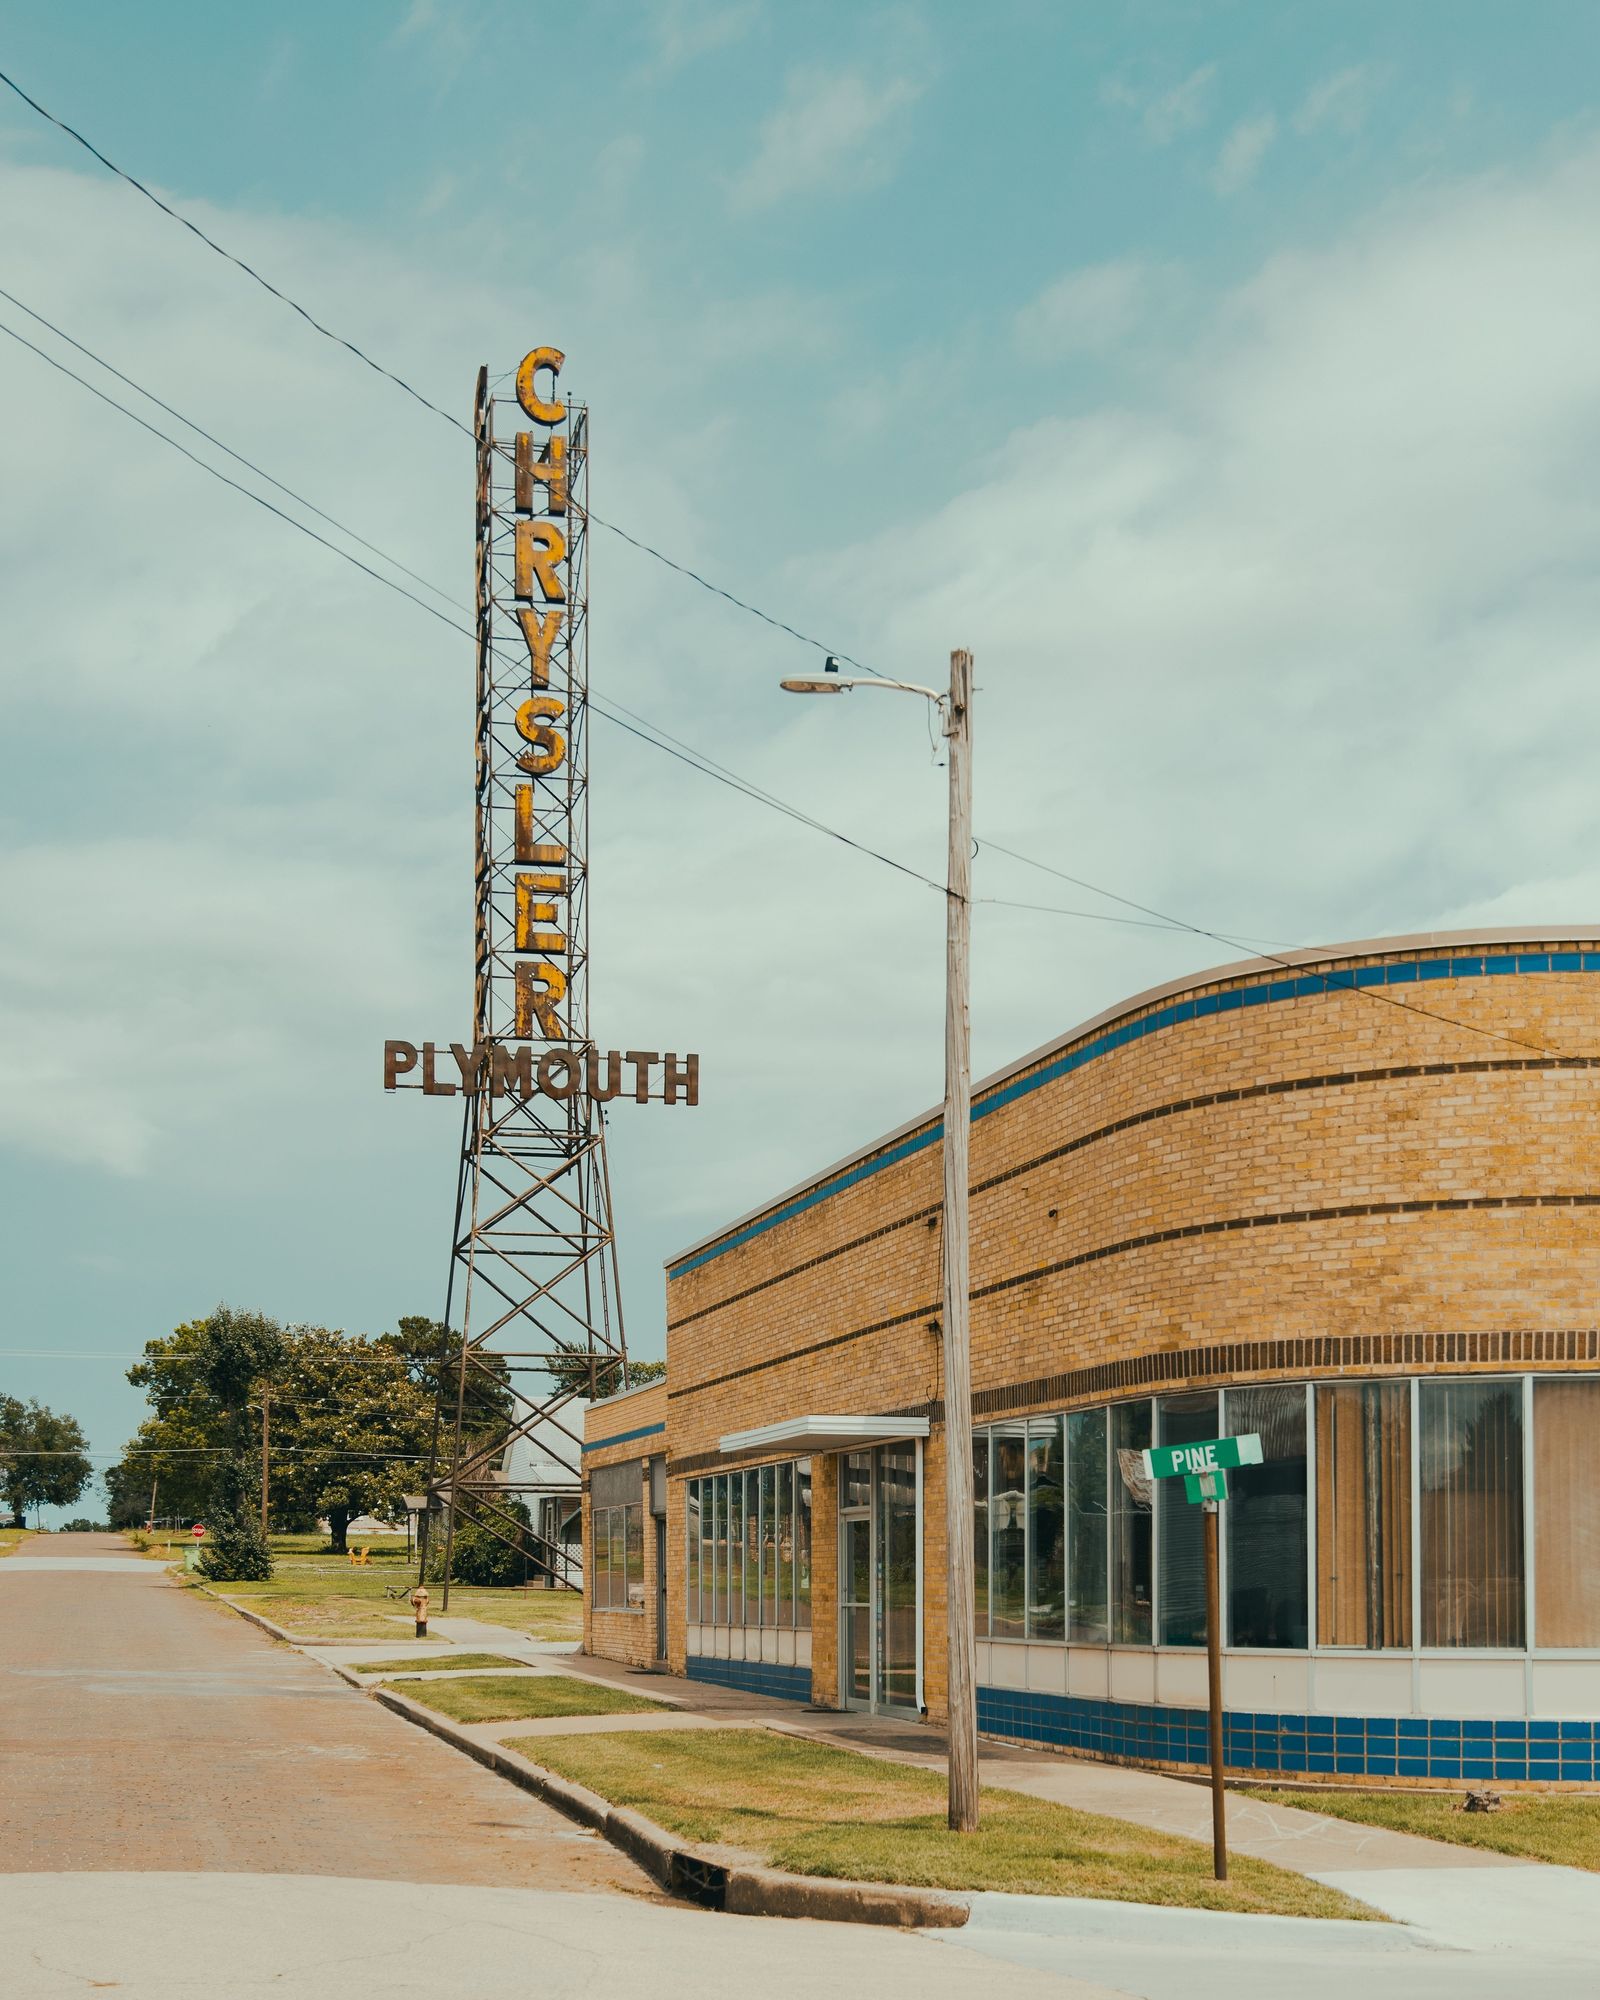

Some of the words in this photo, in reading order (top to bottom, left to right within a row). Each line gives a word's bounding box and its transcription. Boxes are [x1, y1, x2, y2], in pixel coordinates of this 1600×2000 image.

[515, 346, 567, 1039] CHRYSLER
[384, 1040, 698, 1105] PLYMOUTH
[1171, 1445, 1219, 1472] PINE
